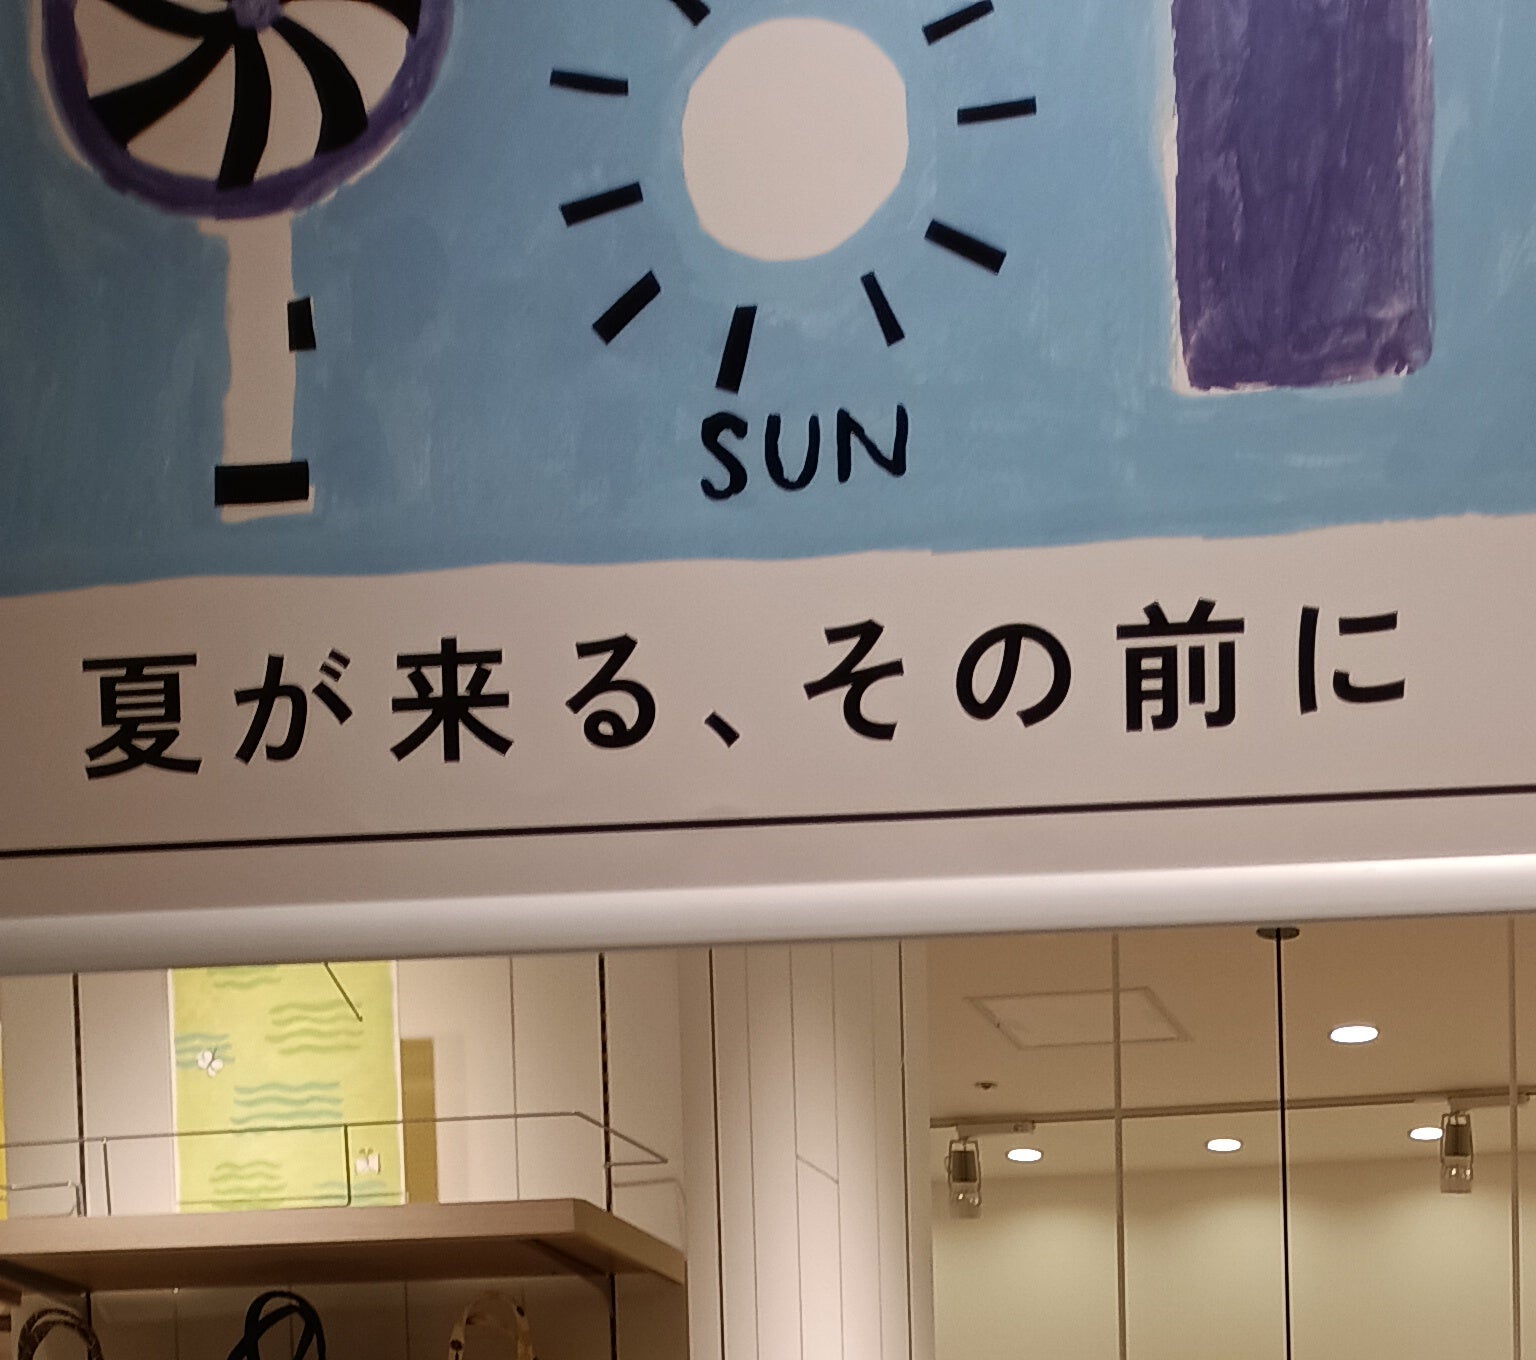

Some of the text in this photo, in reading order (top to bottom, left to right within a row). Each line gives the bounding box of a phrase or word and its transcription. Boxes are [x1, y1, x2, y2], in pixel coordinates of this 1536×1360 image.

[700, 403, 909, 502] SUN
[80, 598, 1406, 781] 夏が来る、その前に
